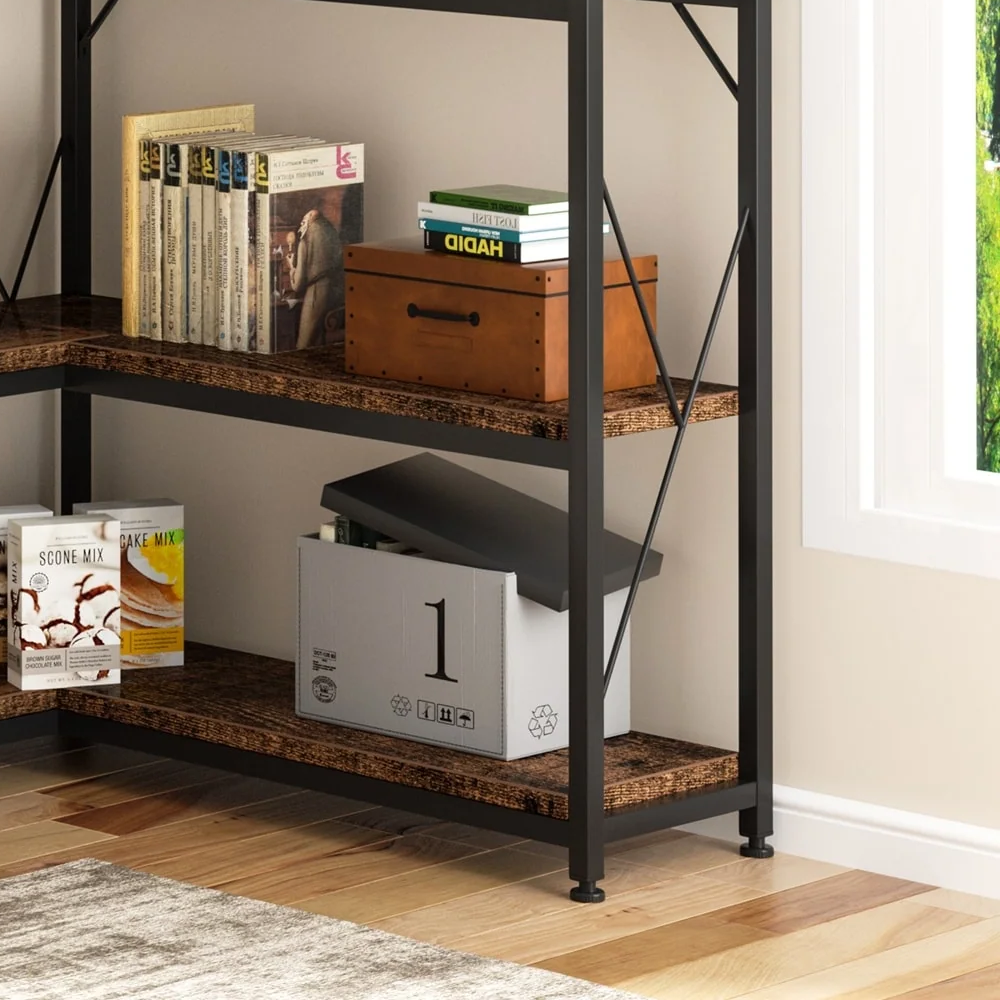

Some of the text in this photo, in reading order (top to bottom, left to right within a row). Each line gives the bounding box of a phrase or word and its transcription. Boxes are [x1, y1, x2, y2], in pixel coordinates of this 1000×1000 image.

[120, 531, 175, 548] CAKE MIX
[39, 548, 104, 566] SCONE MIX
[424, 598, 459, 684] 1
